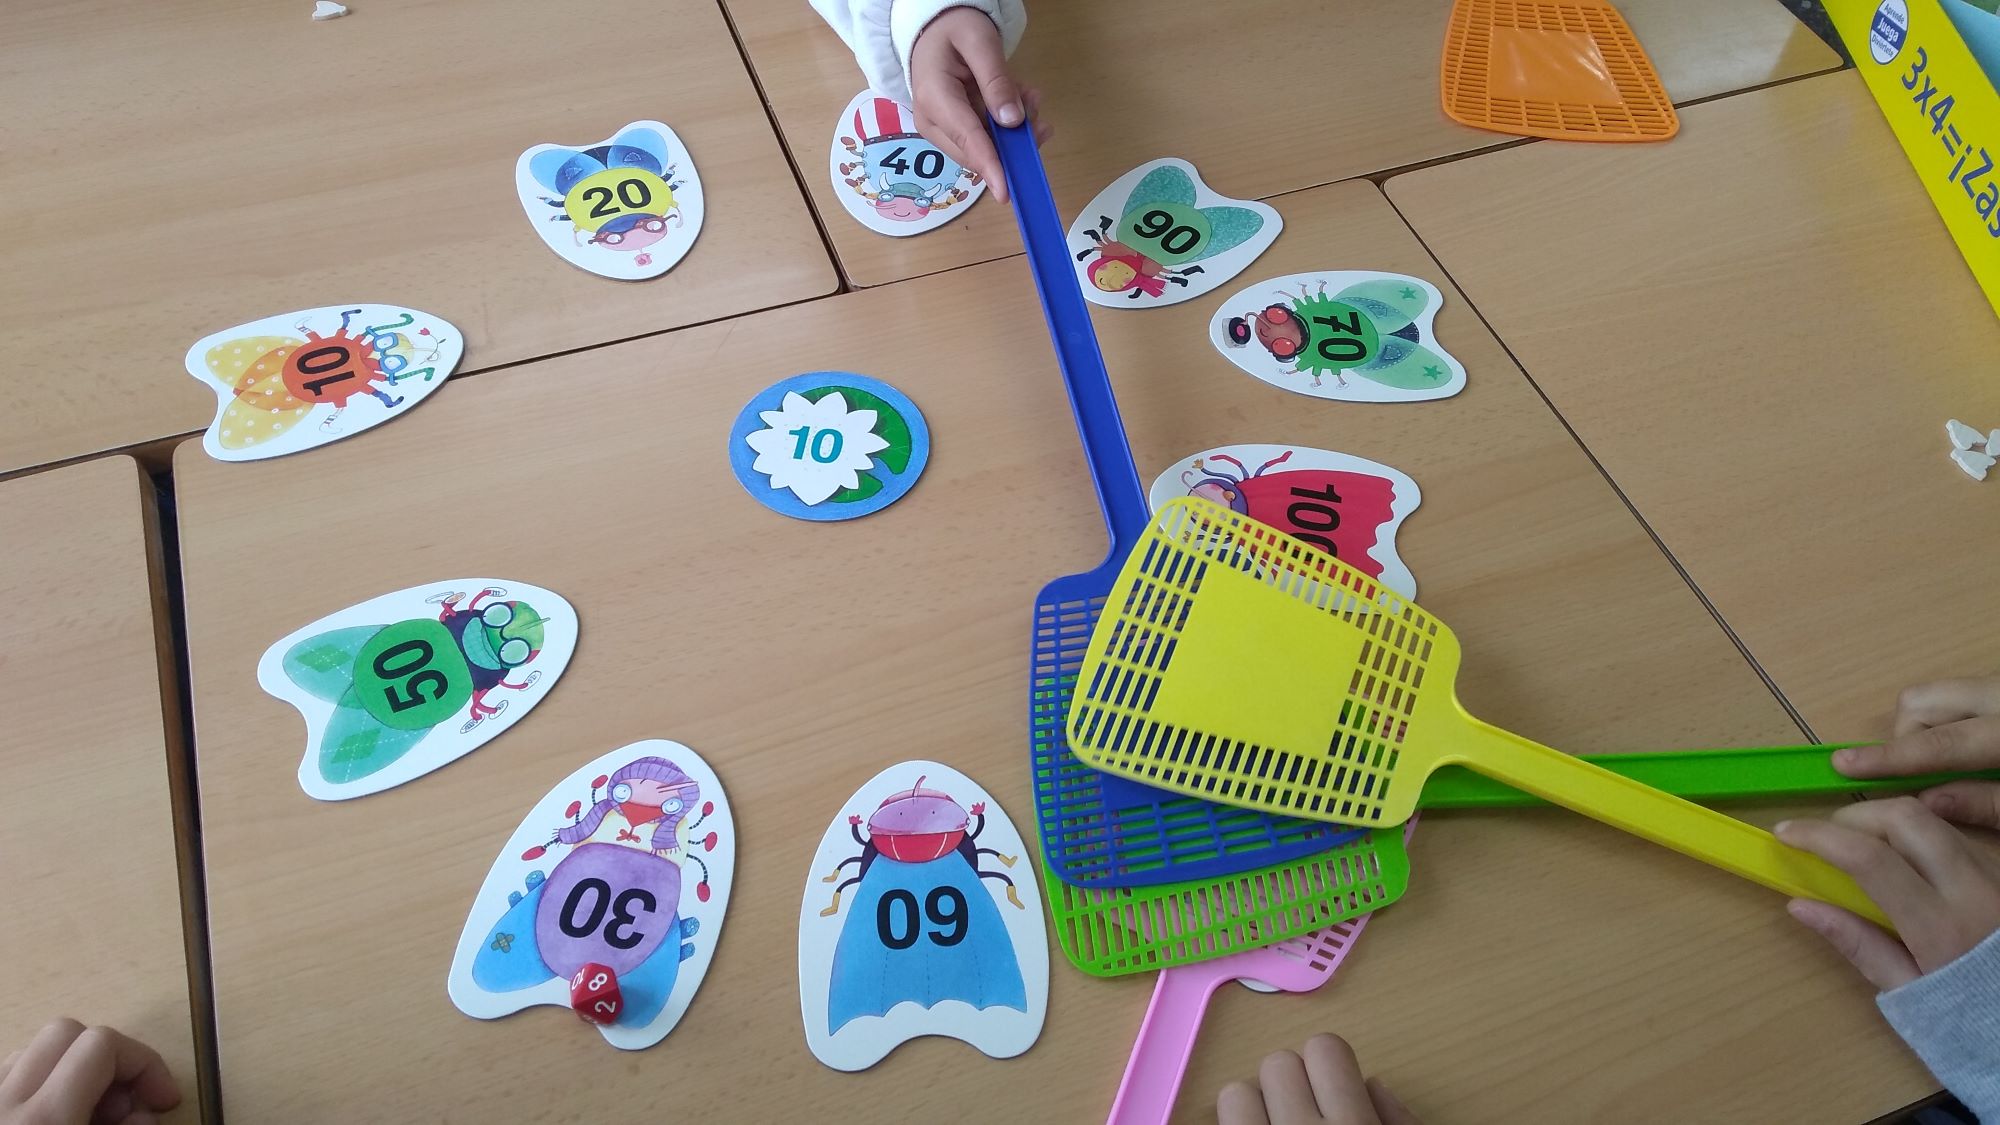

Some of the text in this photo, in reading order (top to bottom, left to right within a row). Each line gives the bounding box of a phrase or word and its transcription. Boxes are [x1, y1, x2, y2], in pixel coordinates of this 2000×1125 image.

[1877, 17, 1899, 42] Juega
[1884, 3, 1905, 24] Aprende
[879, 147, 945, 179] 40
[582, 178, 652, 219] 20
[1133, 210, 1201, 255] 90
[1313, 312, 1367, 361] 70
[296, 346, 356, 396] 10
[788, 425, 844, 464] 10
[372, 639, 449, 714] 50
[558, 878, 657, 950] 30
[876, 886, 969, 950] 60
[588, 972, 608, 991] 8
[594, 1001, 616, 1013] 2
